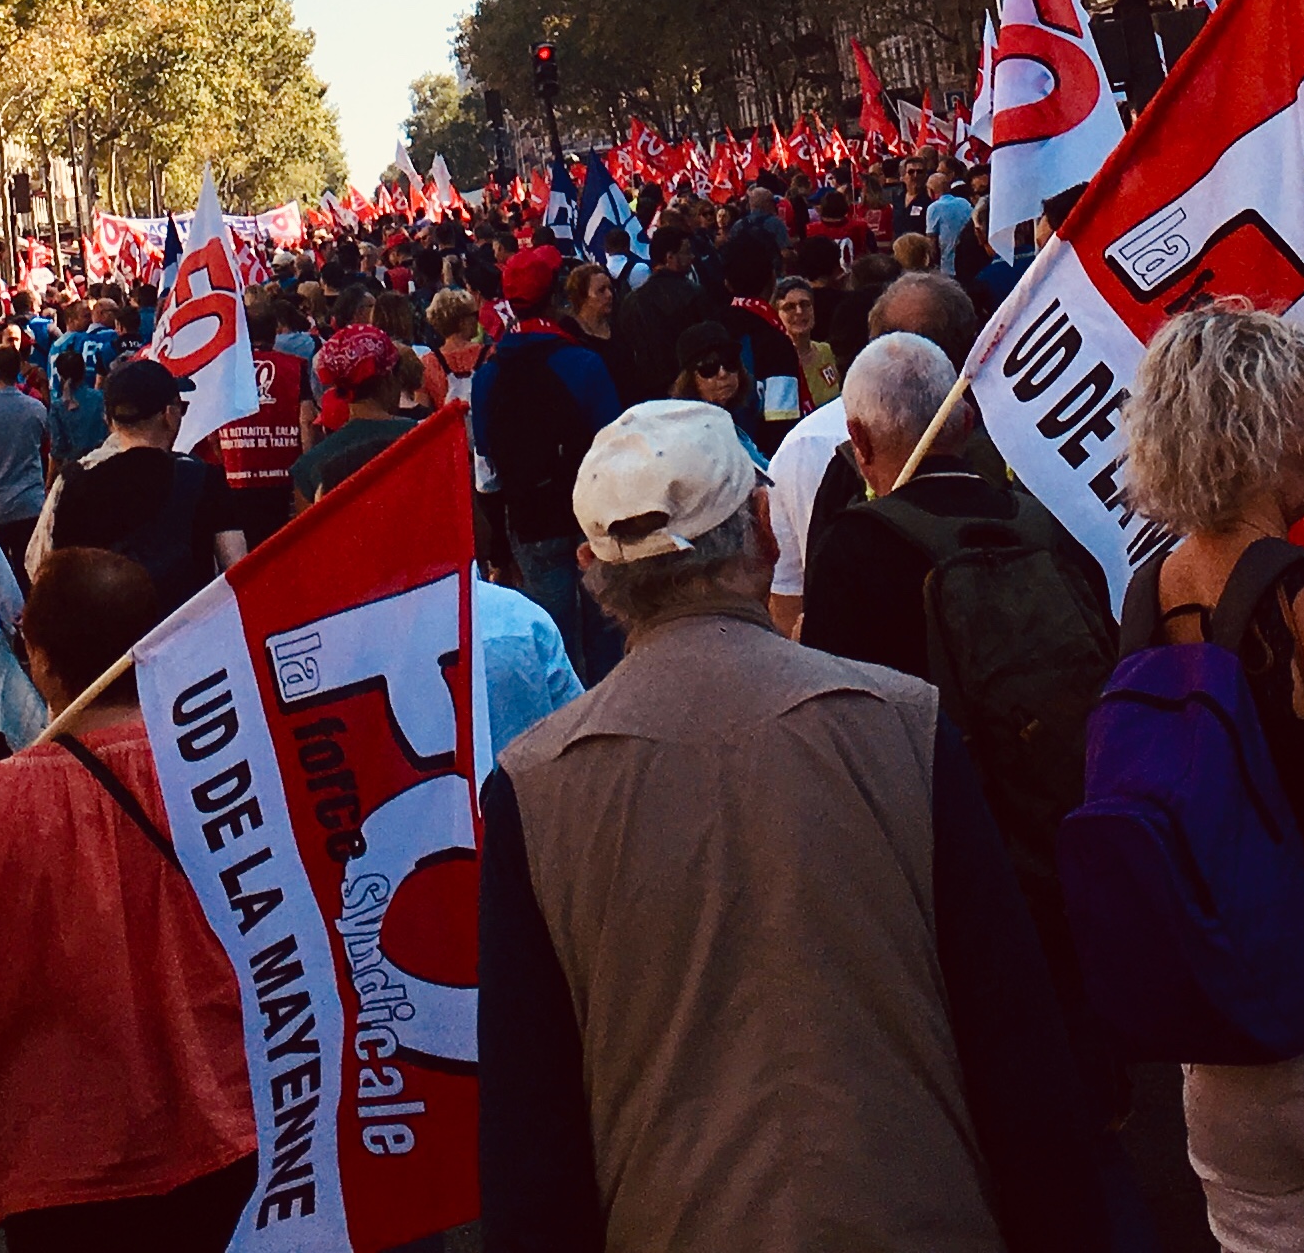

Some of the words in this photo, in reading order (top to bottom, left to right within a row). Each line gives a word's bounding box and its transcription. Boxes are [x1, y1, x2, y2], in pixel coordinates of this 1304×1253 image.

[1118, 207, 1192, 288] la
[1002, 297, 1083, 402] UD
[273, 631, 322, 699] la
[172, 668, 239, 764] UD
[191, 759, 265, 853] DE
[295, 717, 367, 863] force
[218, 848, 283, 937] LA
[334, 872, 426, 1158] syndicale
[249, 933, 322, 1231] MAYENNE
